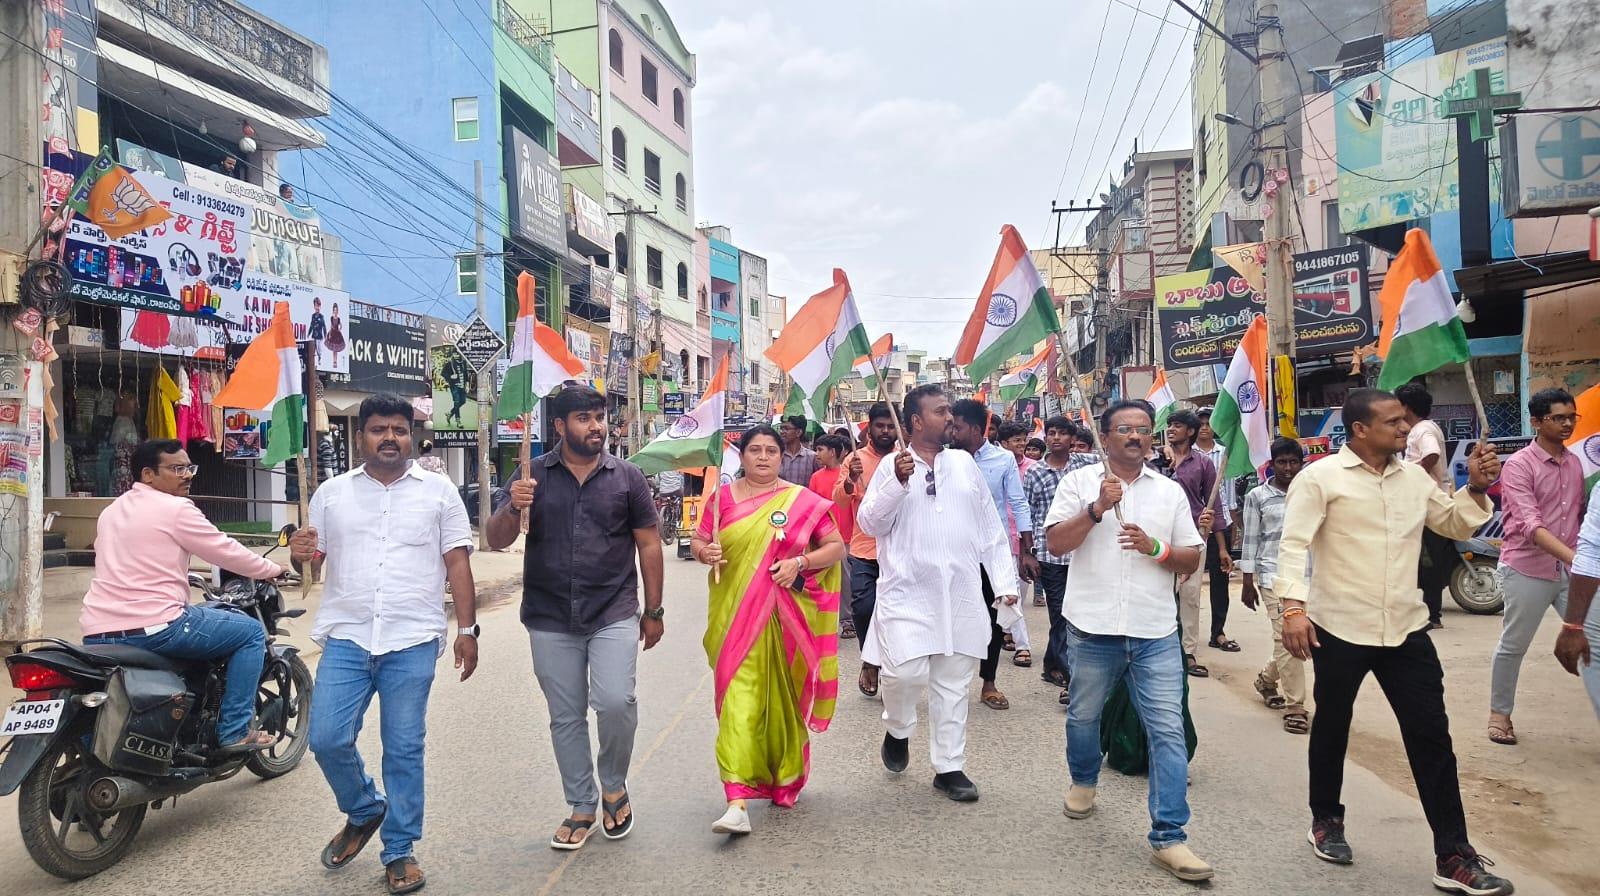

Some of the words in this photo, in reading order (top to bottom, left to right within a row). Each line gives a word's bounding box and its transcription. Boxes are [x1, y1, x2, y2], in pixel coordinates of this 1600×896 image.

[172, 187, 190, 202] Cell
[196, 194, 246, 218] 9133624279
[251, 206, 320, 247] UTIQUE
[1295, 250, 1359, 272] 9441867105
[1165, 281, 1225, 305] బాబు
[349, 338, 372, 363] ACK
[375, 342, 384, 364] &
[386, 344, 425, 369] WHITE
[434, 431, 458, 441] BLACK
[459, 431, 464, 441] &
[17, 703, 51, 715] AP04
[4, 722, 21, 733] AP
[23, 718, 55, 731] 9489
[124, 735, 172, 760] CLAS
